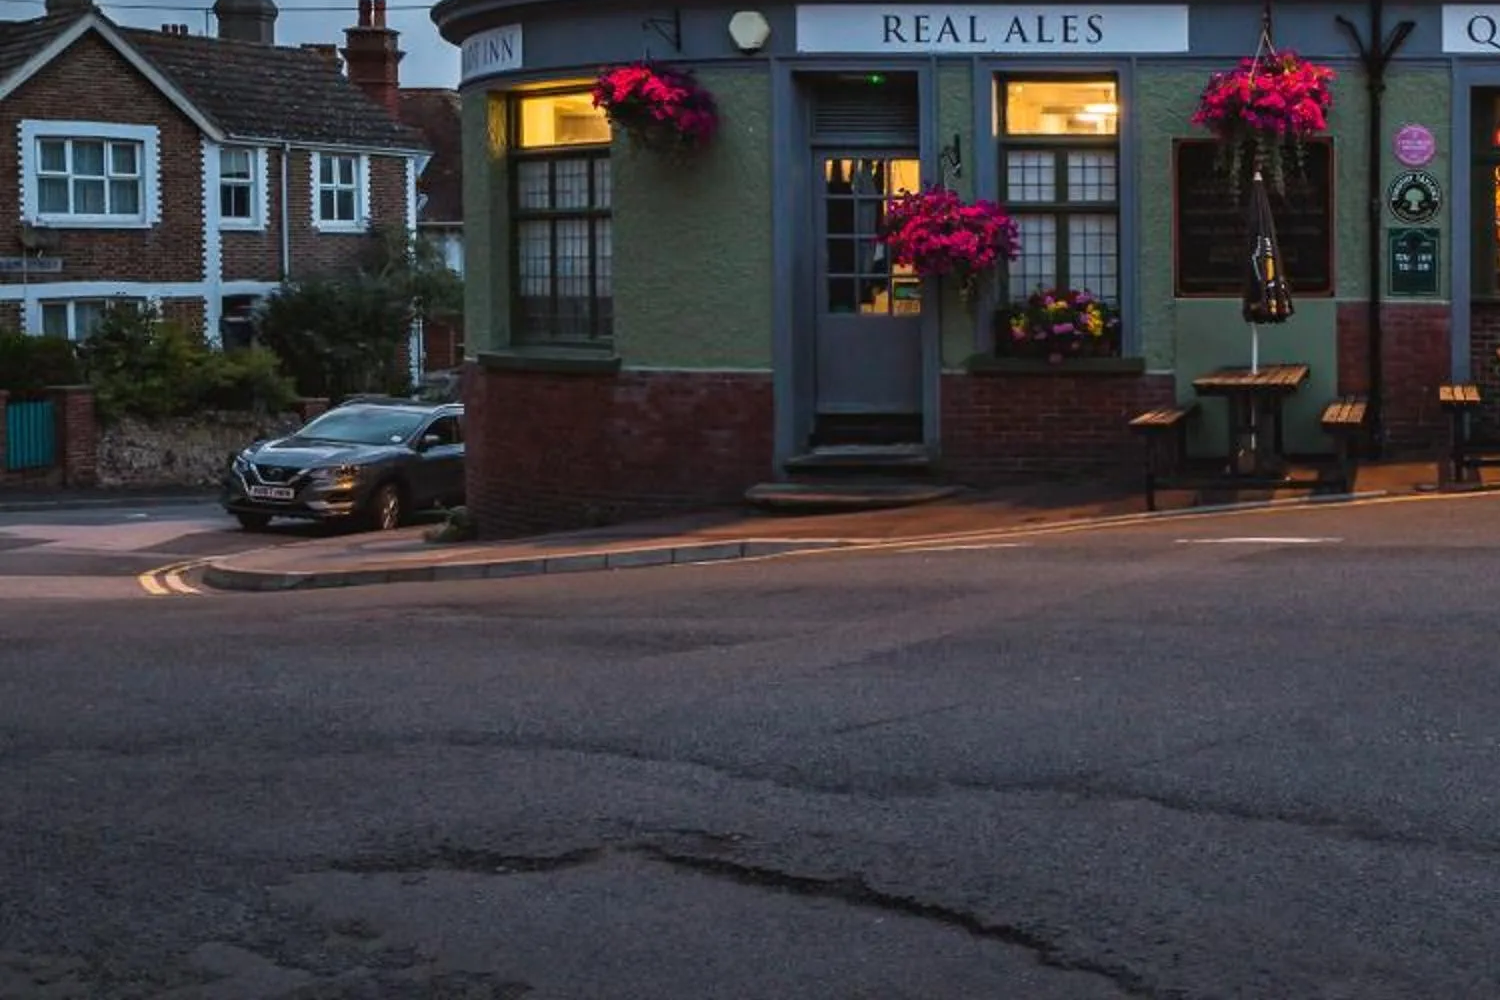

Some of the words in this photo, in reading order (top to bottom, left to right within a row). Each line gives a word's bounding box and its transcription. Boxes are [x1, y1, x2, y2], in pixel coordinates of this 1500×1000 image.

[881, 14, 988, 44] REAL
[1003, 13, 1104, 44] ALES
[483, 33, 513, 65] INN
